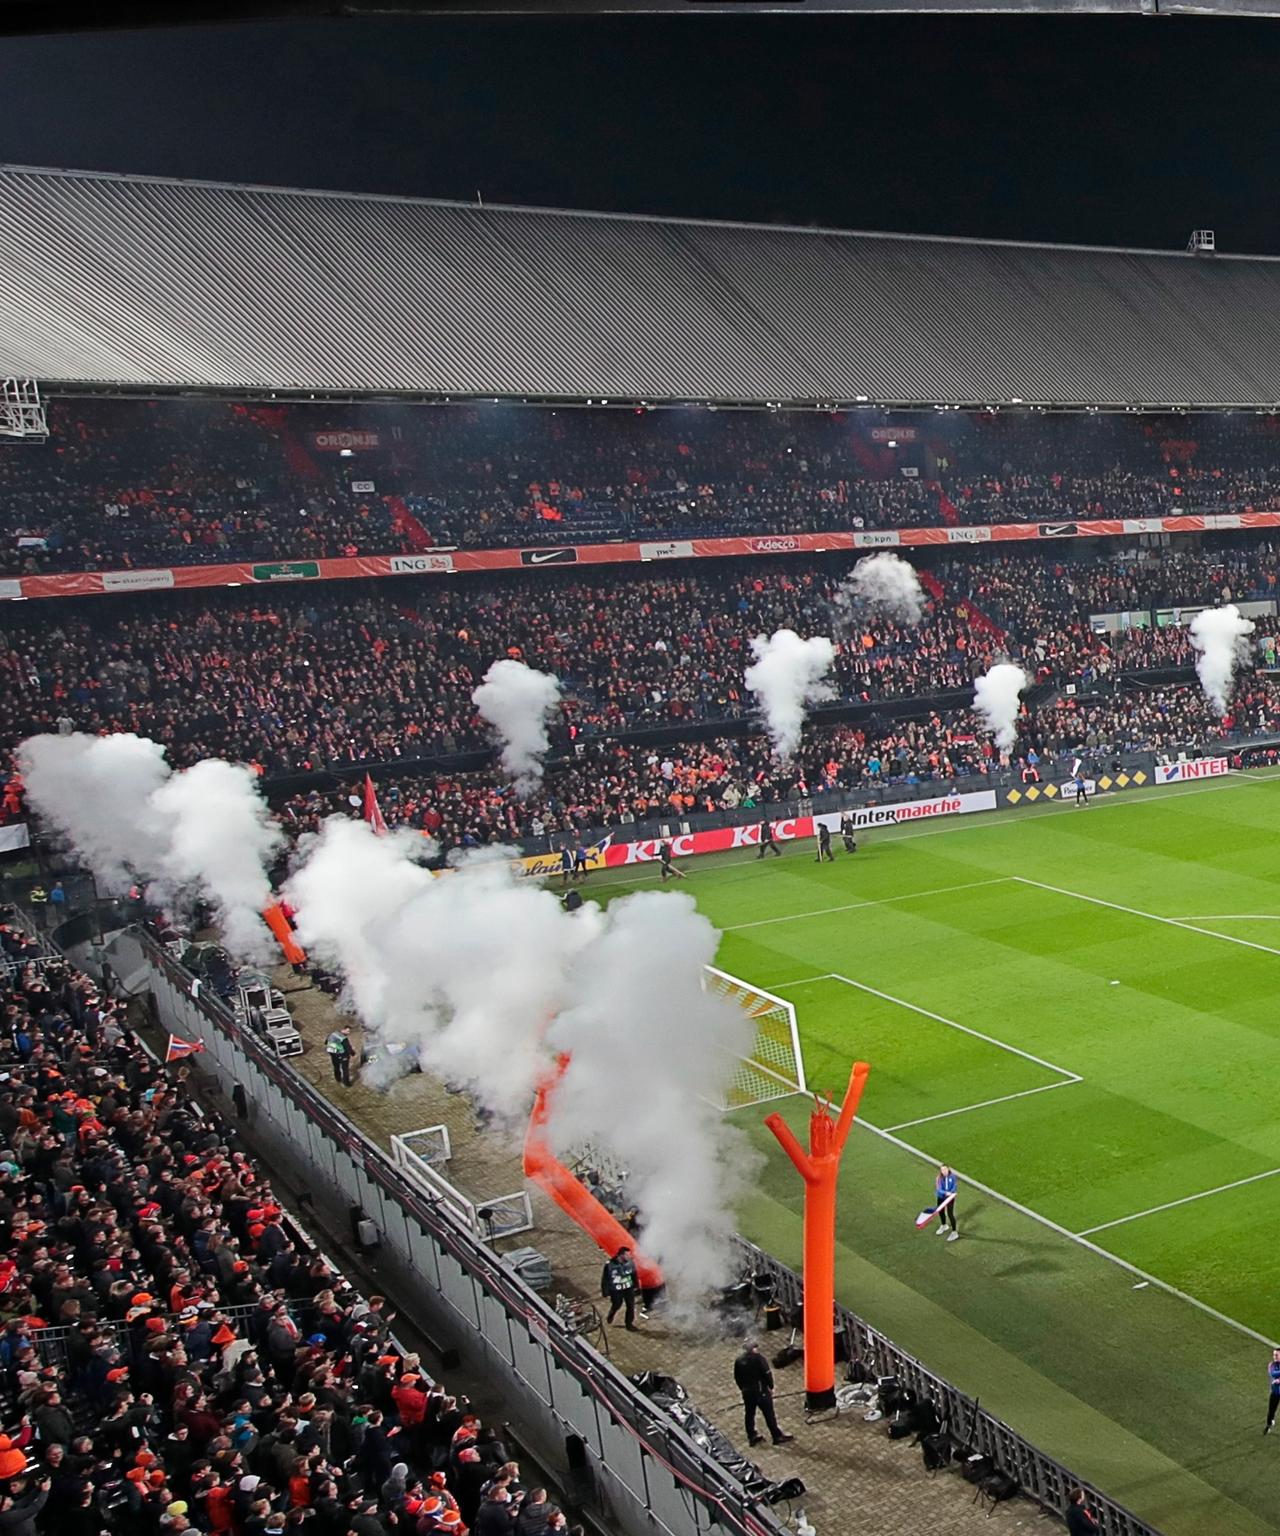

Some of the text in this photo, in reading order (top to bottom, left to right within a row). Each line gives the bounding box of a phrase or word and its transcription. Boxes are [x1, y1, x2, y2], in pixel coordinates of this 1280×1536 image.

[874, 535, 892, 545] kpn
[950, 528, 974, 541] ING
[756, 539, 796, 551] Adecco
[394, 558, 427, 572] ING
[852, 798, 961, 826] Intermarché
